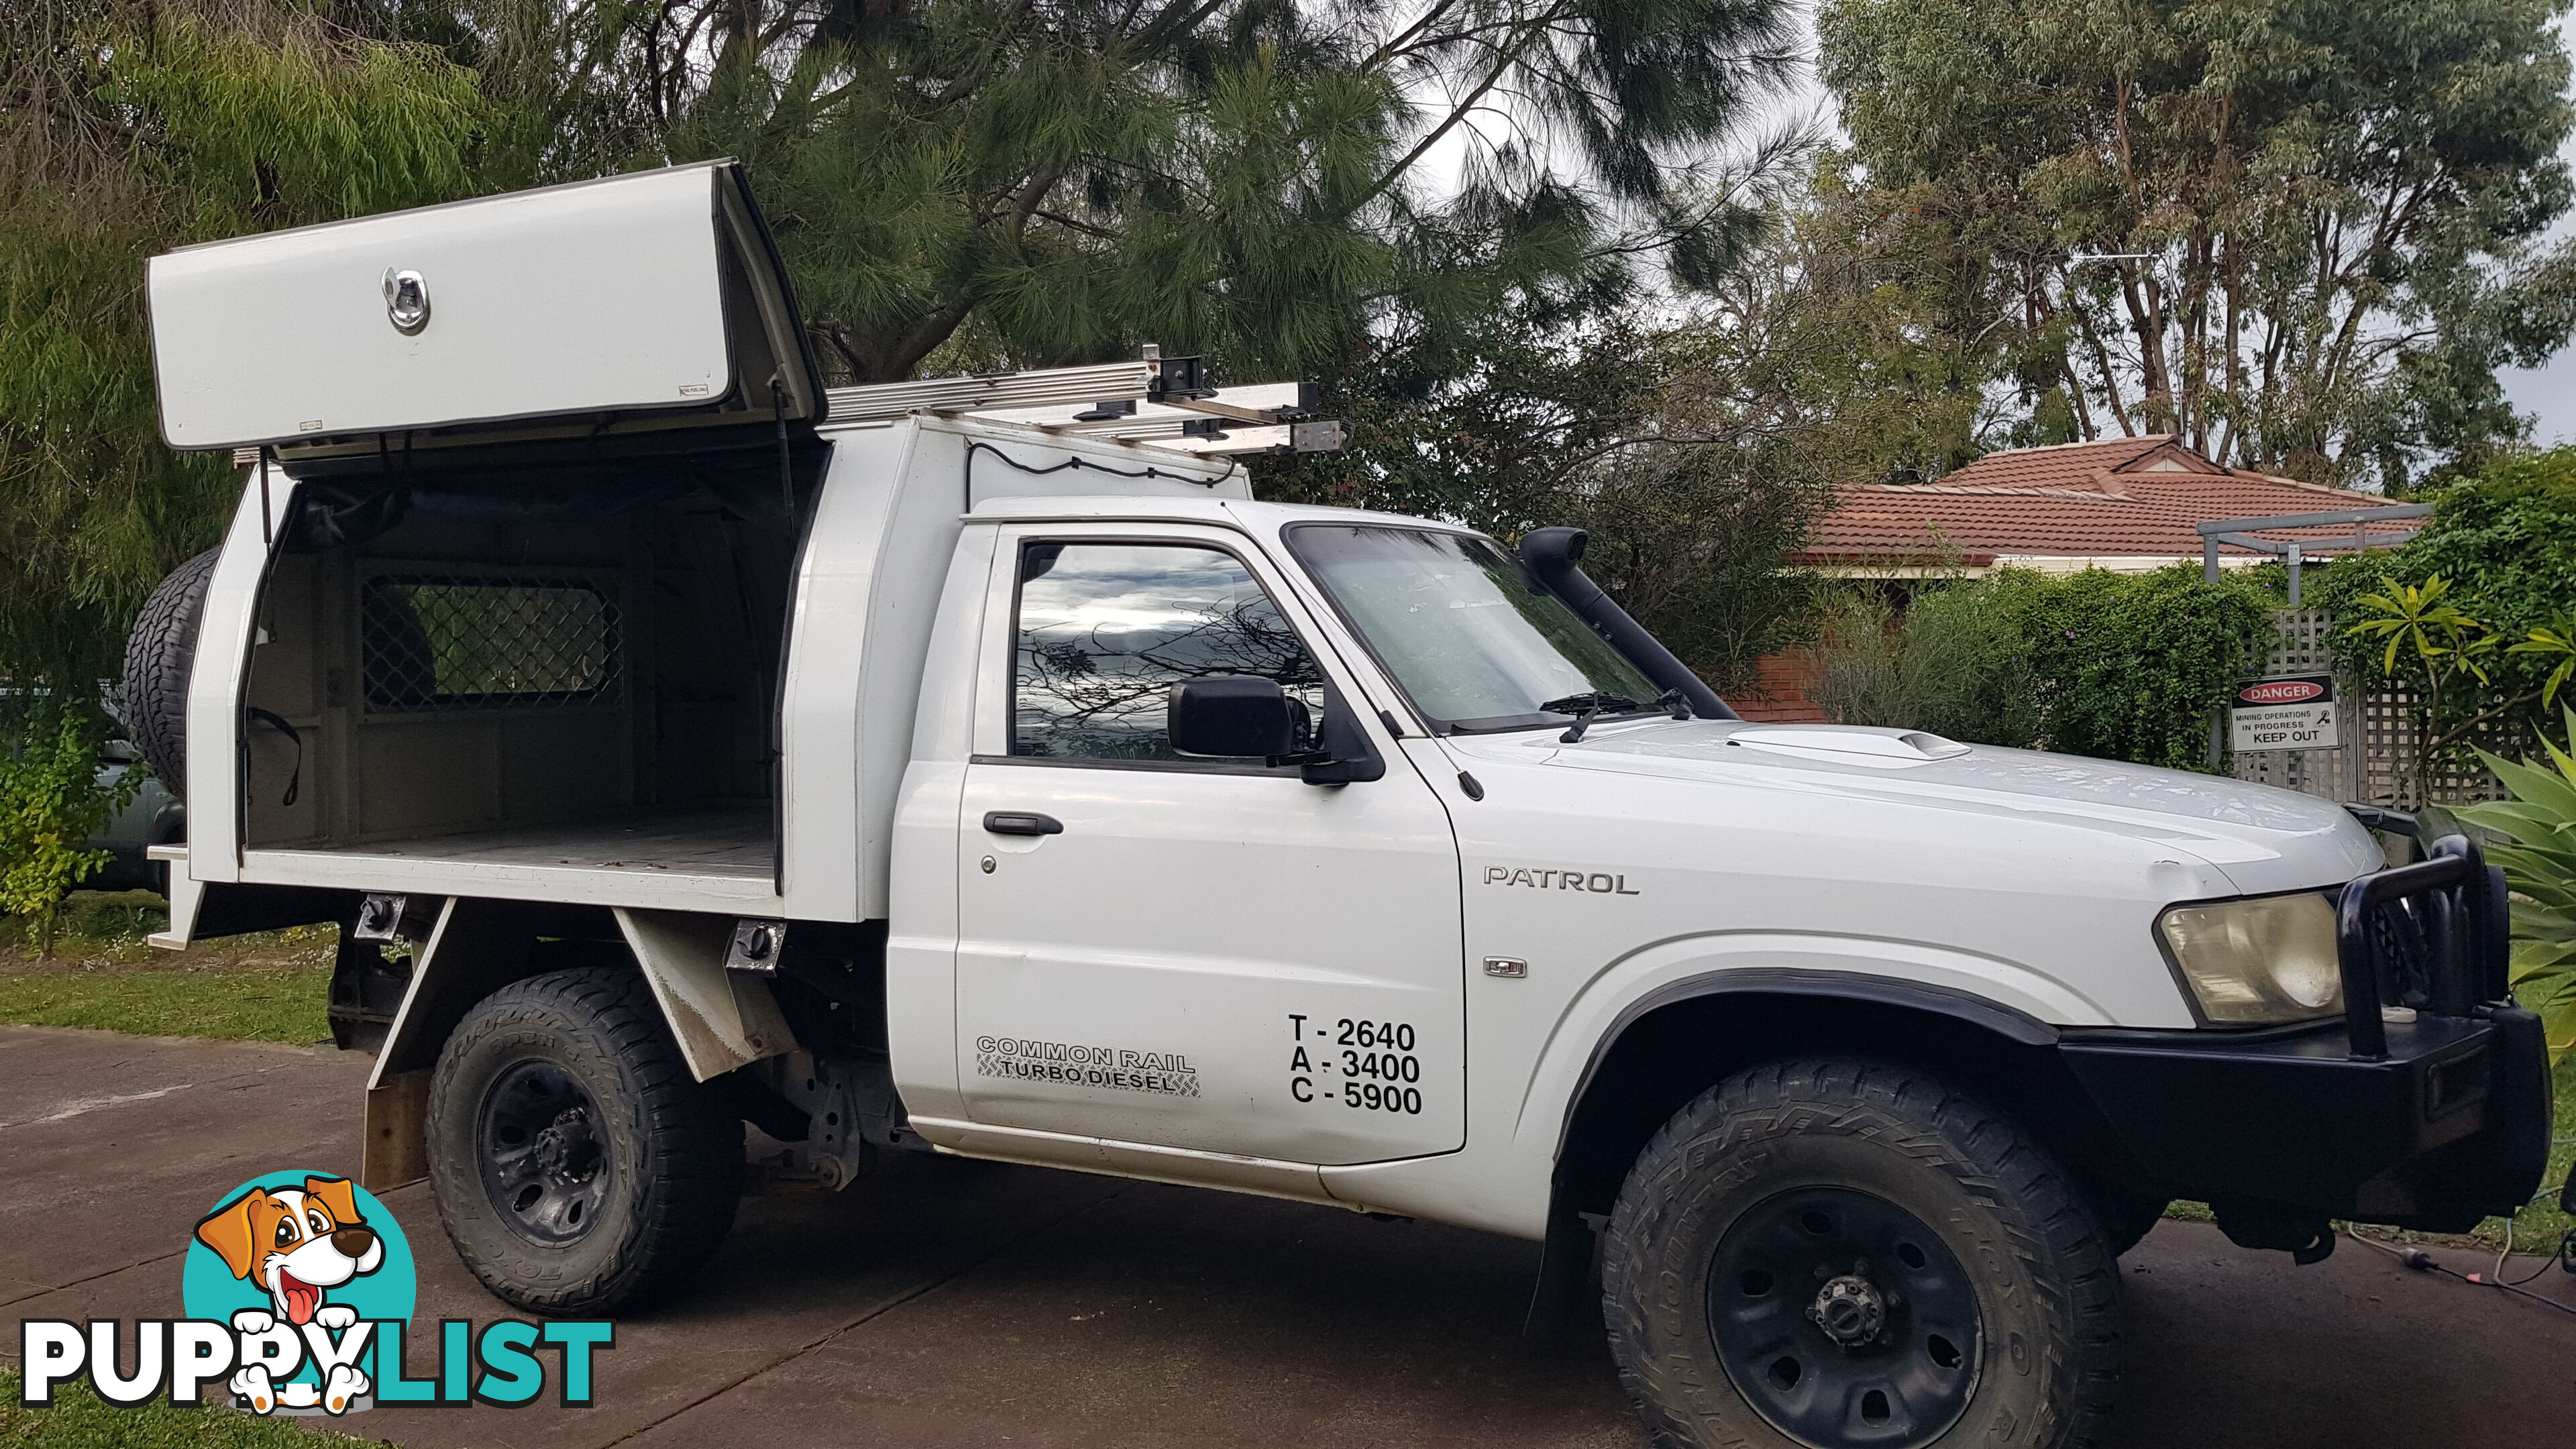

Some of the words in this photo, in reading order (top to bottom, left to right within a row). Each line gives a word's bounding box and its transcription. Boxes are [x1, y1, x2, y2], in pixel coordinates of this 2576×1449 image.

[2251, 686, 2310, 700] DANGER
[2255, 721, 2304, 731] PROGRESS
[2265, 710, 2311, 719] OPERATIONS
[2254, 733, 2287, 743] KEEP
[2292, 731, 2320, 741] OUT
[1484, 865, 1640, 895] PATROL
[1289, 1014, 1307, 1041] T
[1337, 1018, 1415, 1051] 2640
[976, 1035, 1113, 1066] COMMON
[1120, 1049, 1196, 1074] RAIL
[1291, 1046, 1312, 1073] A
[1342, 1050, 1419, 1083] 3400
[1000, 1060, 1082, 1082] TURBO
[1088, 1072, 1177, 1092] DIESEL
[1291, 1076, 1313, 1102] C
[1345, 1081, 1421, 1114] 5900
